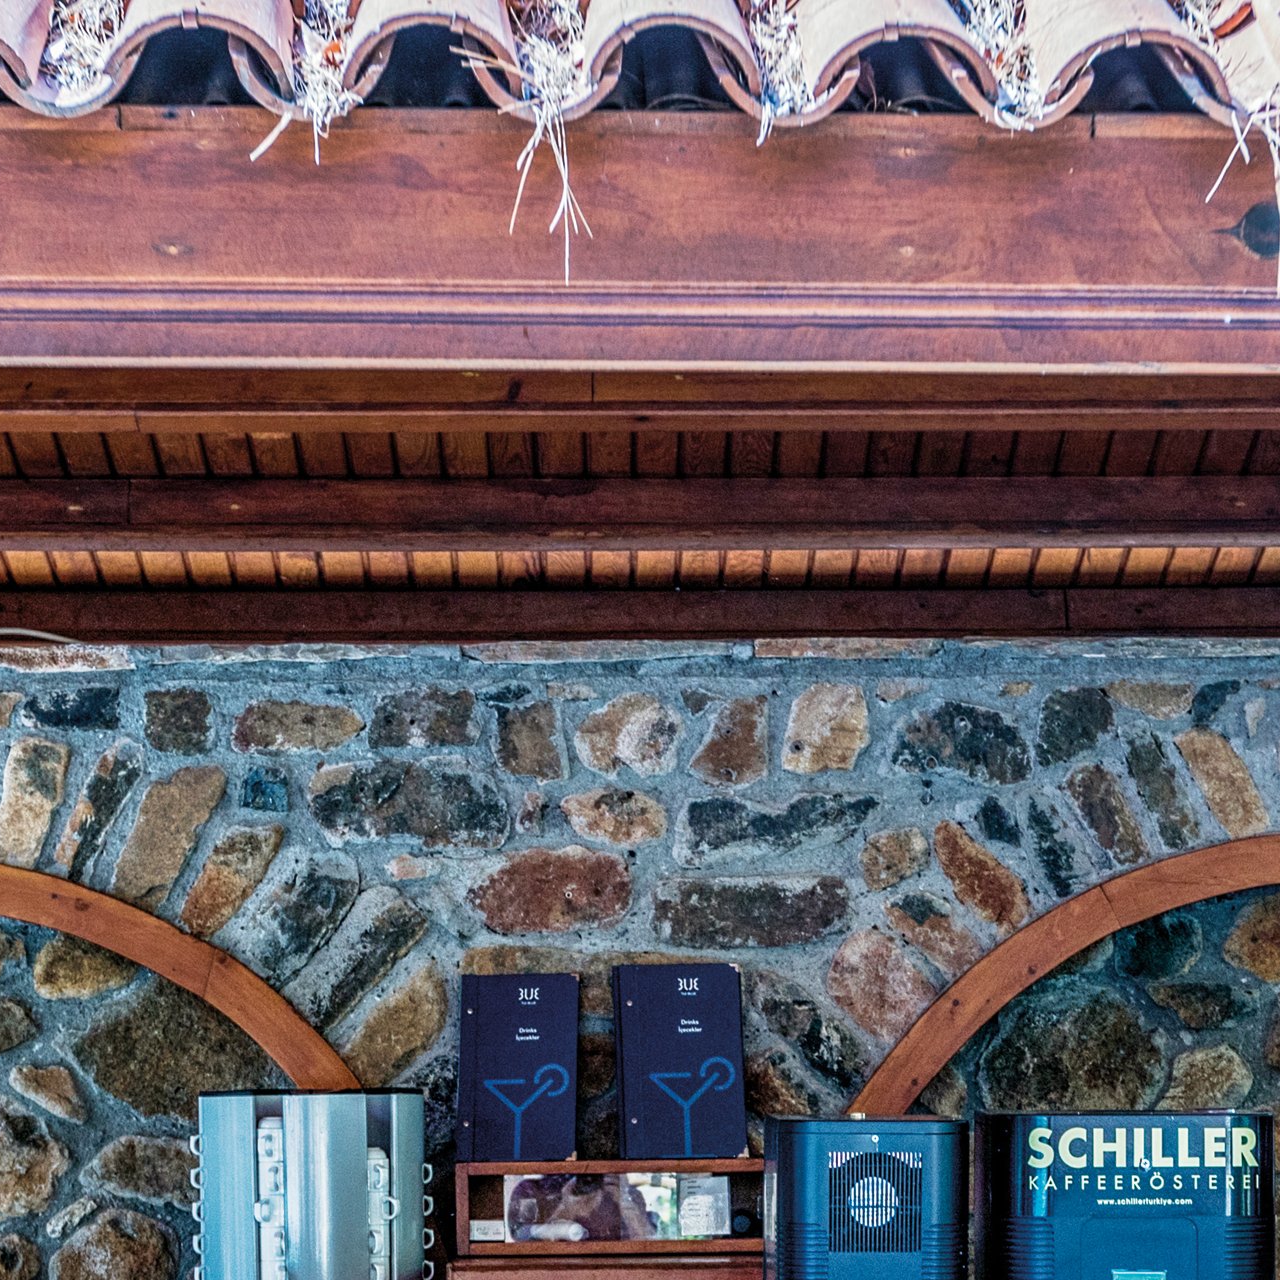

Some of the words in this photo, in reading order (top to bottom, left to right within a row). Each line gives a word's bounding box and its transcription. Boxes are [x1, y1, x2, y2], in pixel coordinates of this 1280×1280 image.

[680, 1018, 699, 1026] Drinks
[1027, 1127, 1259, 1169] SCHILLER
[1028, 1172, 1260, 1191] KAFFEERÖSTEREI
